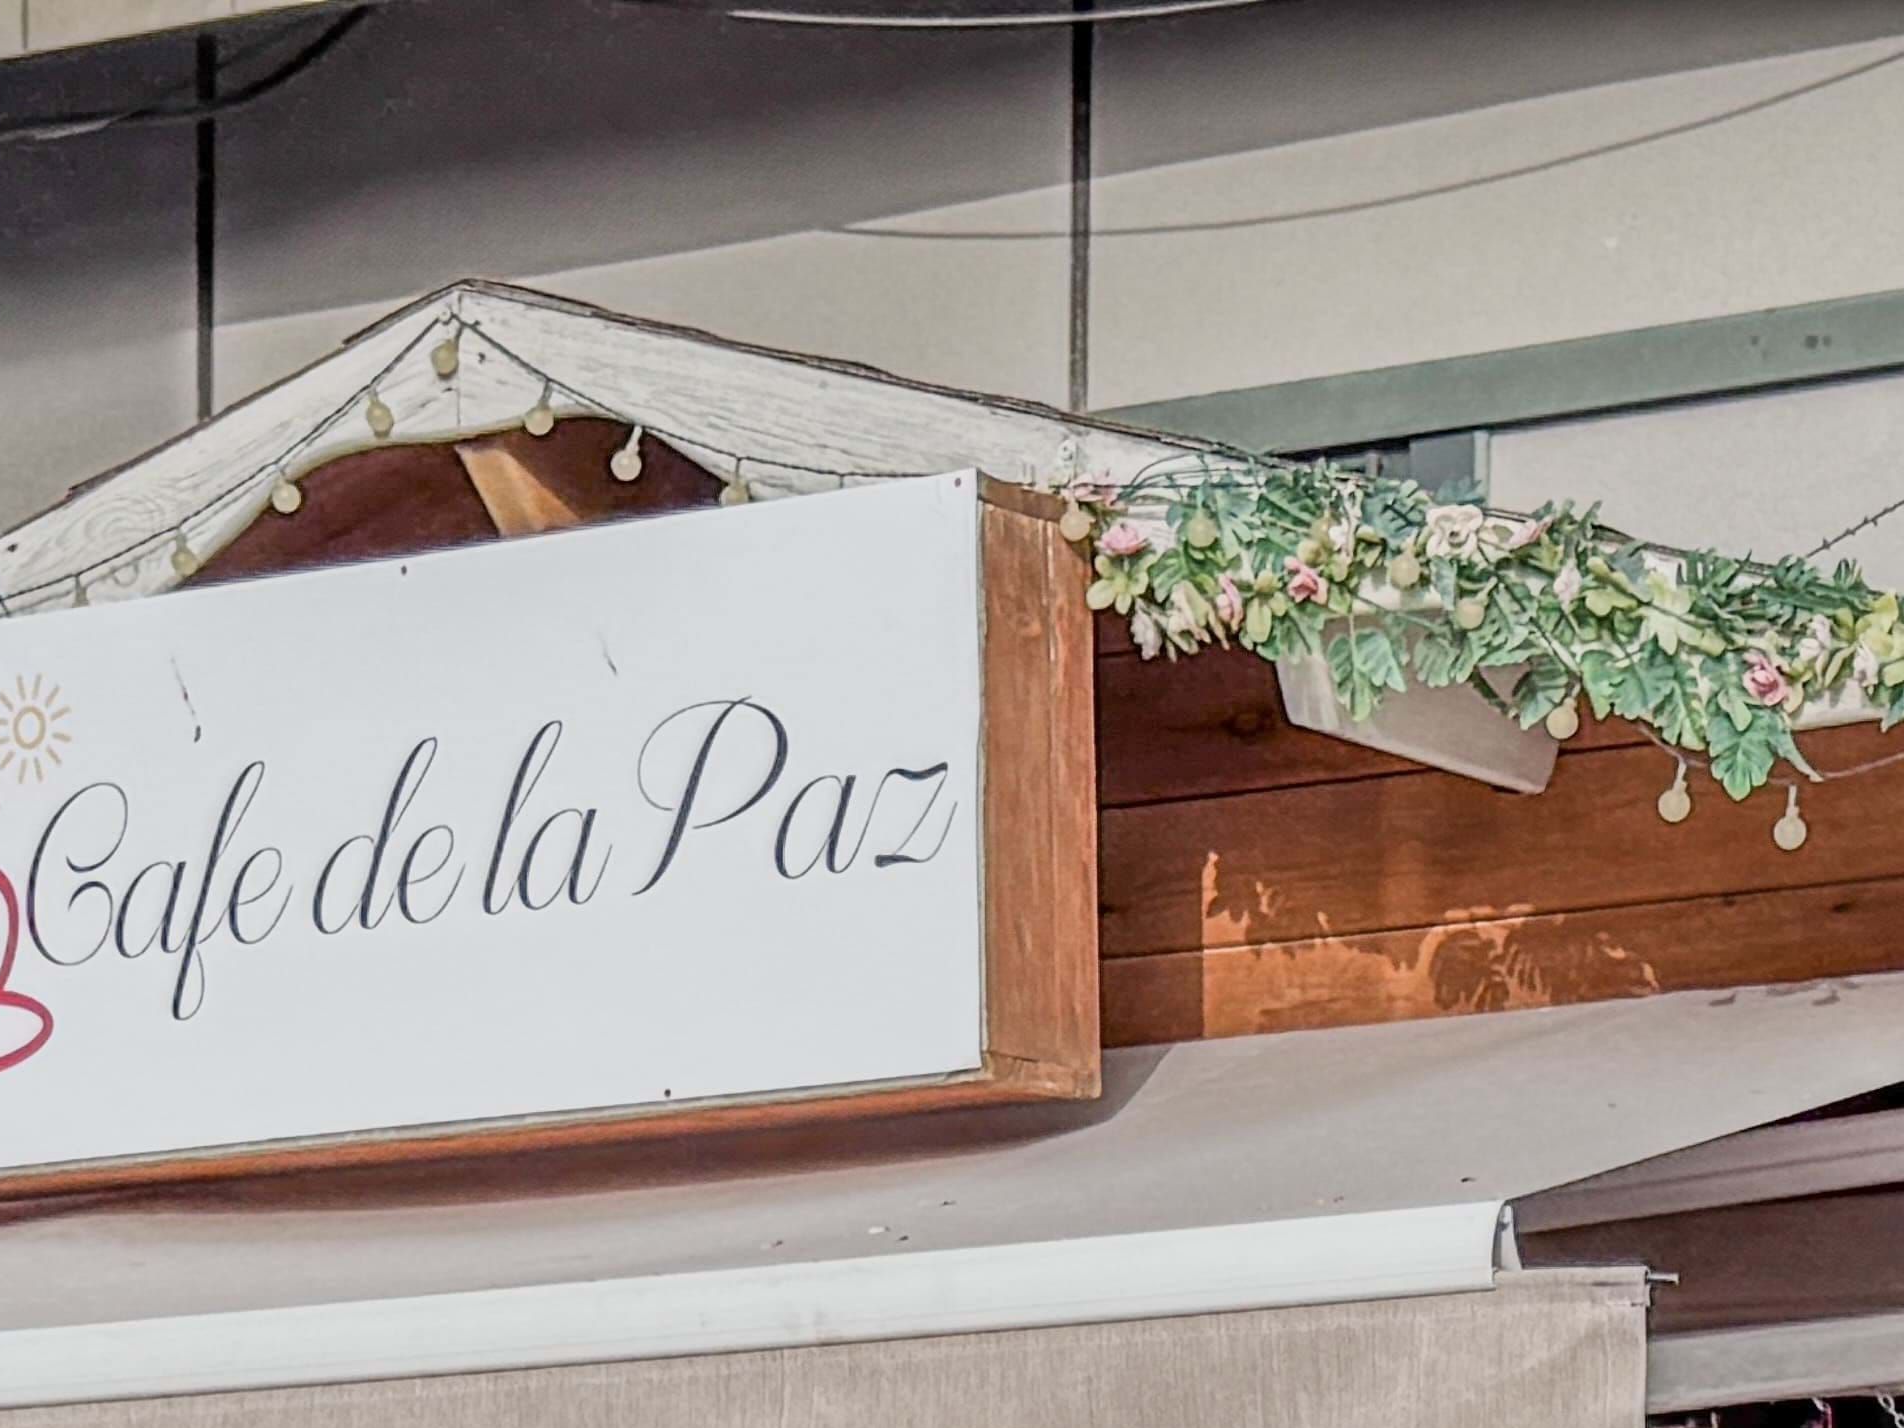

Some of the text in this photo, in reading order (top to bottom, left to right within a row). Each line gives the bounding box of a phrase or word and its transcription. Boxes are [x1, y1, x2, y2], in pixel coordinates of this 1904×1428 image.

[26, 695, 959, 1022] Cafe de la Paz
